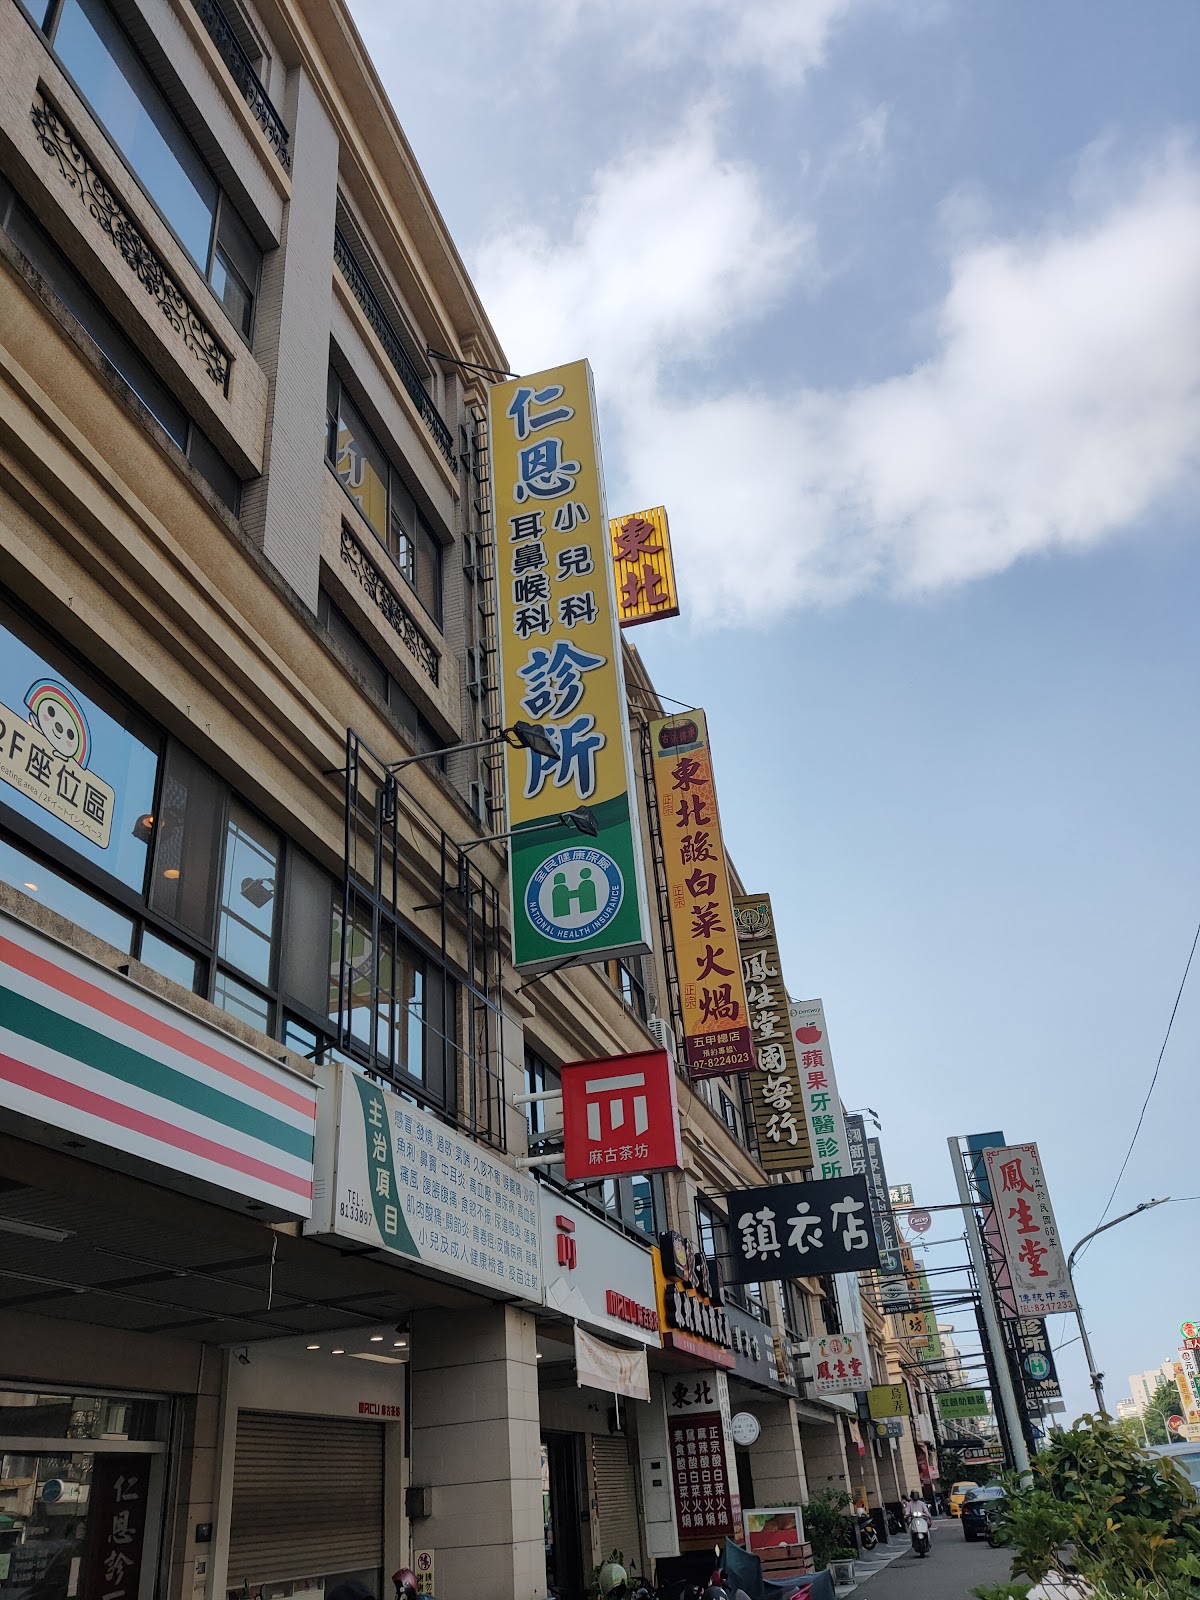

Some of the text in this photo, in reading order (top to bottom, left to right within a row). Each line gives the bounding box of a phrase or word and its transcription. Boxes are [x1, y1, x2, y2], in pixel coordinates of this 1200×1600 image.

[508, 509, 553, 640] 耳鼻喉科
[552, 500, 599, 629] 小兒科
[614, 518, 669, 609] 東北
[505, 384, 606, 799] 仁恩 診所
[0, 763, 23, 787] eating
[534, 850, 612, 883] 全民健康保險
[529, 884, 620, 938] NATIONAL HEALTH INSURANCE
[685, 983, 696, 1009] 正宗
[693, 1031, 740, 1048] 五甲總店
[693, 1053, 749, 1070] 07-8224023
[394, 1110, 412, 1134] 感冒
[416, 1122, 433, 1147] 發燒
[801, 1050, 843, 1179] 蘋果牙醫診所
[368, 1097, 398, 1236] 主治項目
[588, 1144, 649, 1165] 麻古茶坊
[441, 1163, 465, 1190] 中耳炎
[339, 1202, 373, 1227] 8133897
[347, 1189, 364, 1207] TEL:
[737, 1195, 869, 1261] 鎮衣店
[1000, 1157, 1050, 1278] 鳳生堂
[816, 1357, 863, 1380] 鳳生堂
[671, 1380, 714, 1409] 東北
[102, 1475, 139, 1600] 仁恩診
